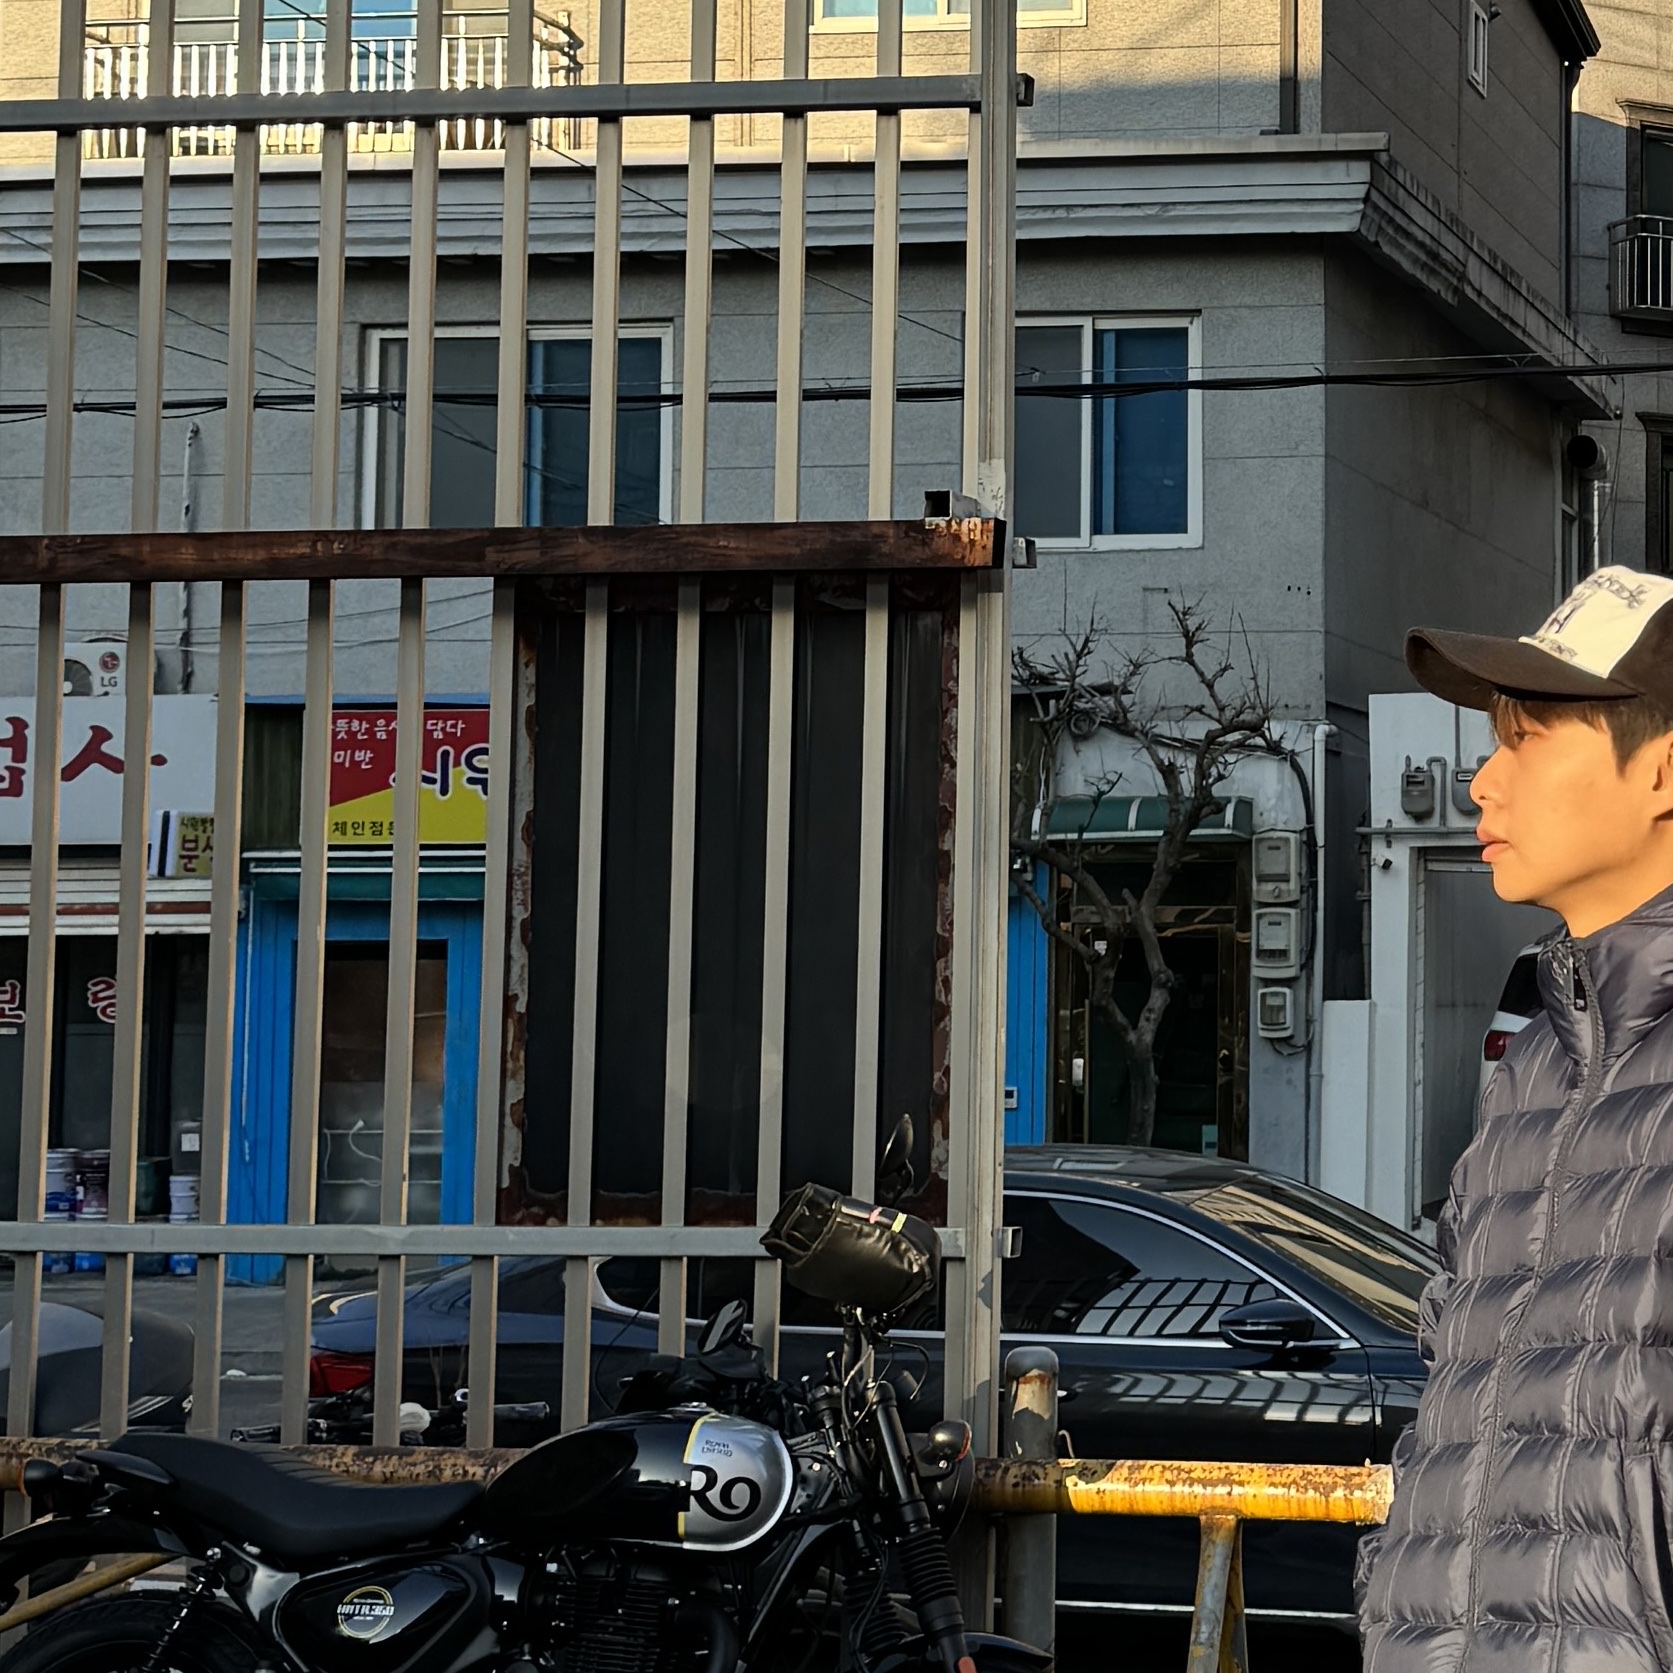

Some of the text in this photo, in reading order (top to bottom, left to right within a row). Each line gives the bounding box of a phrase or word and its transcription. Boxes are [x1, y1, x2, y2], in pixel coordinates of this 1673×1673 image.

[101, 677, 118, 688] LG
[331, 718, 370, 740] 뜻한
[374, 718, 398, 740] 음
